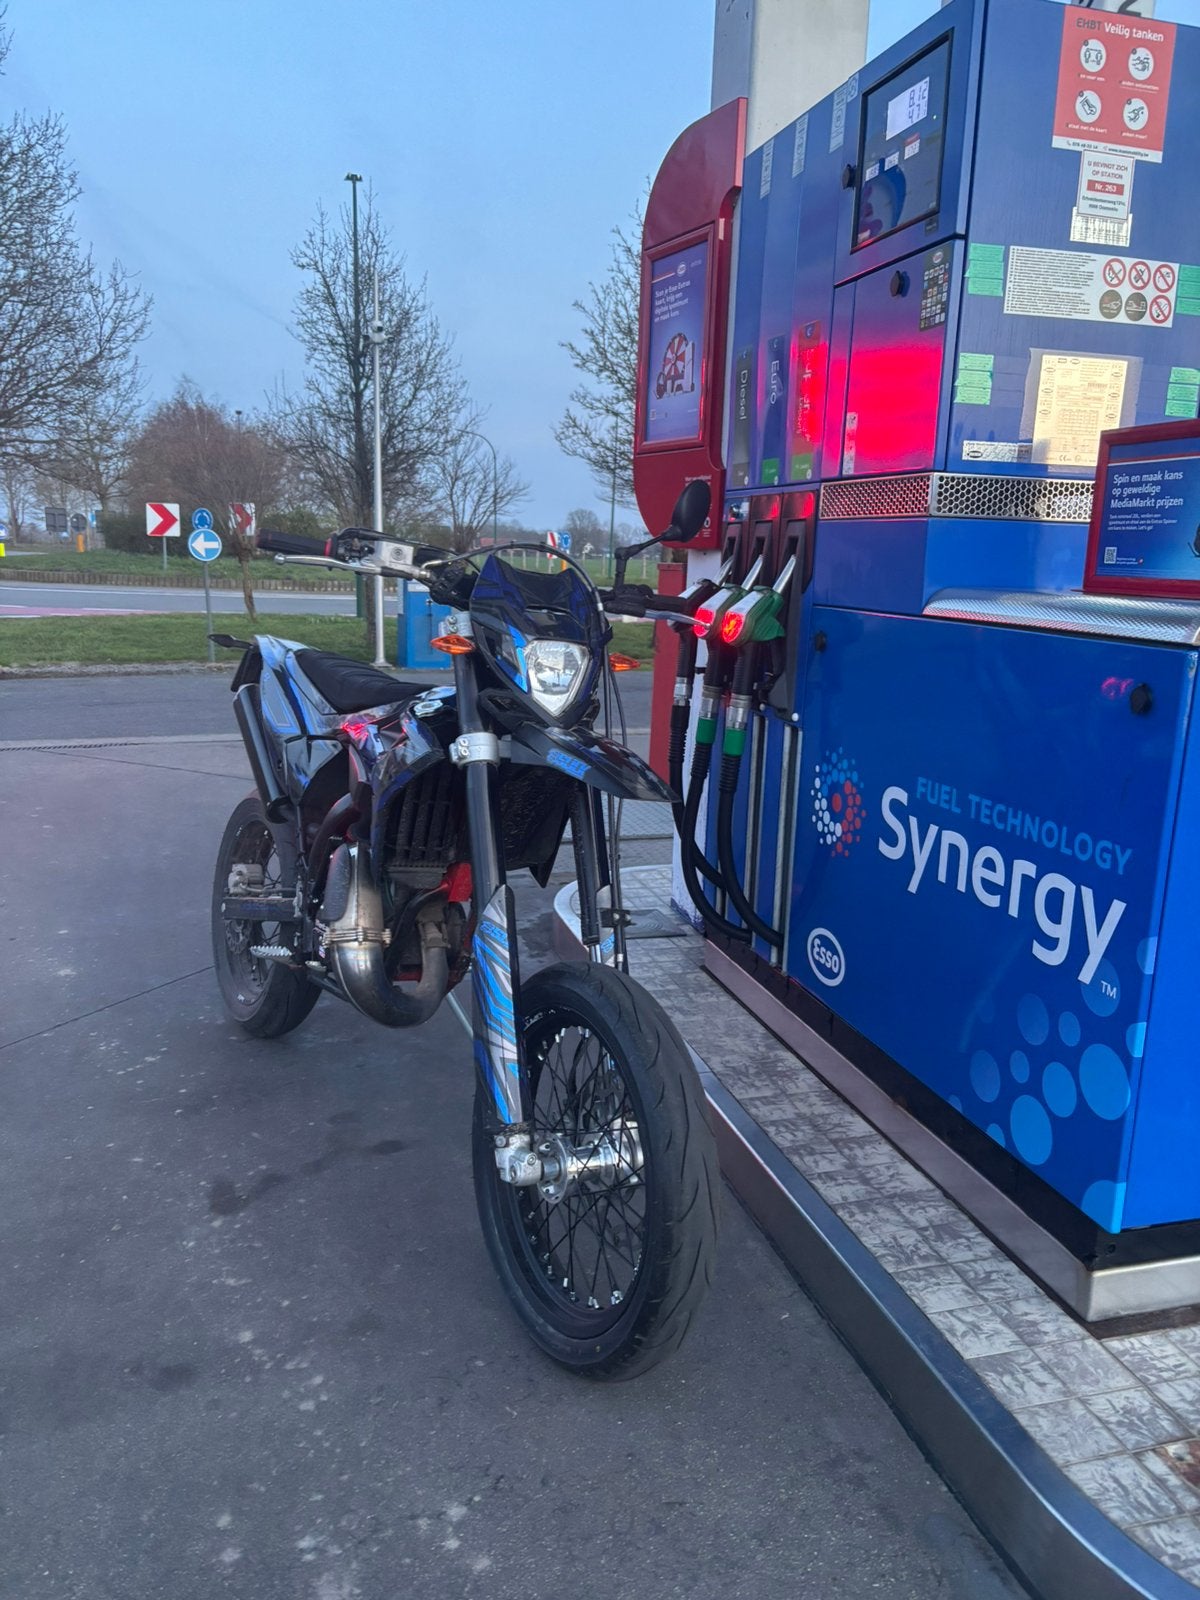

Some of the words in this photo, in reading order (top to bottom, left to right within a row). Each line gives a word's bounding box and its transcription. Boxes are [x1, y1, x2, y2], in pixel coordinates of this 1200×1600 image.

[1076, 17, 1102, 30] EHBT
[1104, 22, 1131, 38] Veilig
[1132, 28, 1164, 42] tanken
[1101, 171, 1123, 179] STATION
[770, 360, 780, 404] Euro
[1111, 487, 1122, 497] op
[1122, 483, 1161, 497] geweldige
[1113, 473, 1129, 486] Spin
[1141, 471, 1163, 481] maak
[1163, 470, 1184, 480] kans
[1110, 496, 1155, 509] MediaMarkt
[1155, 496, 1184, 509] prijzen
[916, 776, 962, 814] FUEL
[968, 794, 1133, 875] TECHNOLOGY
[878, 786, 1128, 985] Synergy
